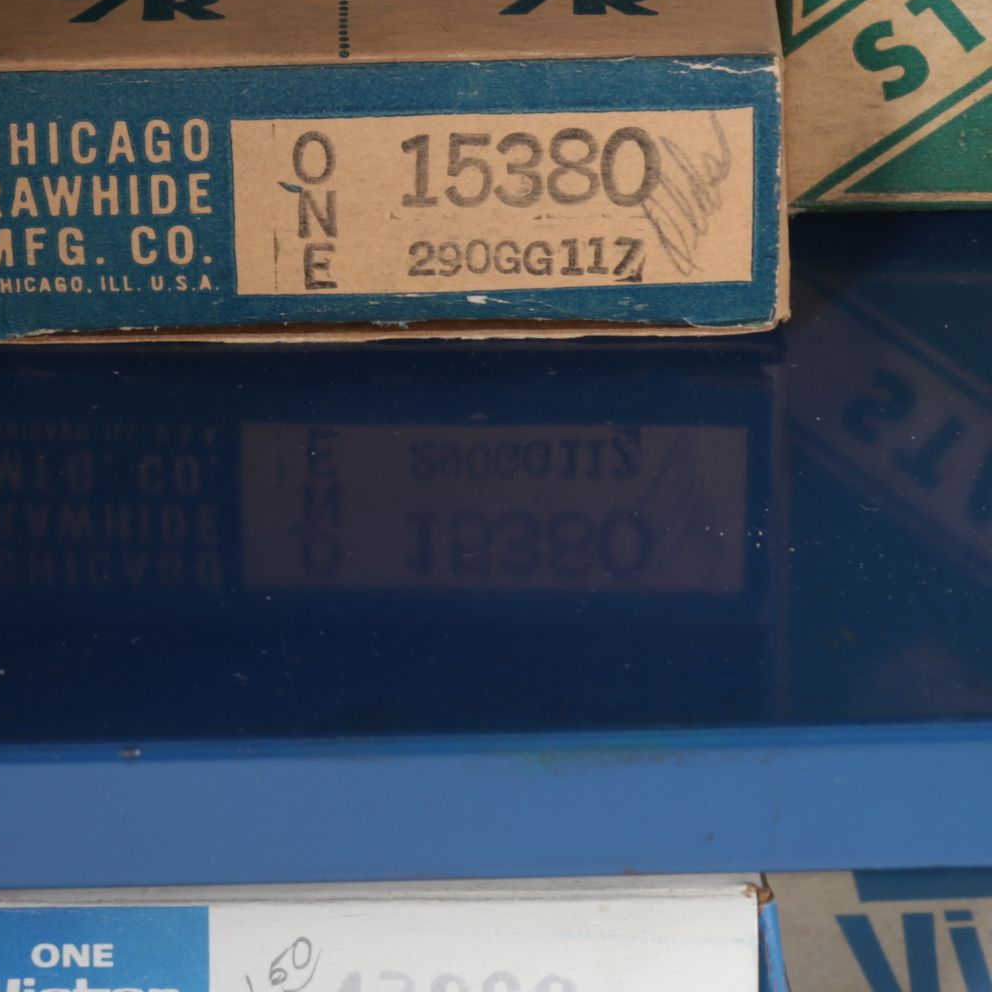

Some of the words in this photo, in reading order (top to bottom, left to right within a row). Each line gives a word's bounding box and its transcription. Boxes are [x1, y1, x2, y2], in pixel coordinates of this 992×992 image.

[401, 126, 661, 208] 15380
[291, 130, 339, 291] ONE
[130, 224, 212, 266] CO.
[408, 236, 646, 283] 290GG117
[100, 275, 142, 293] ILL.
[31, 943, 114, 968] ONE
